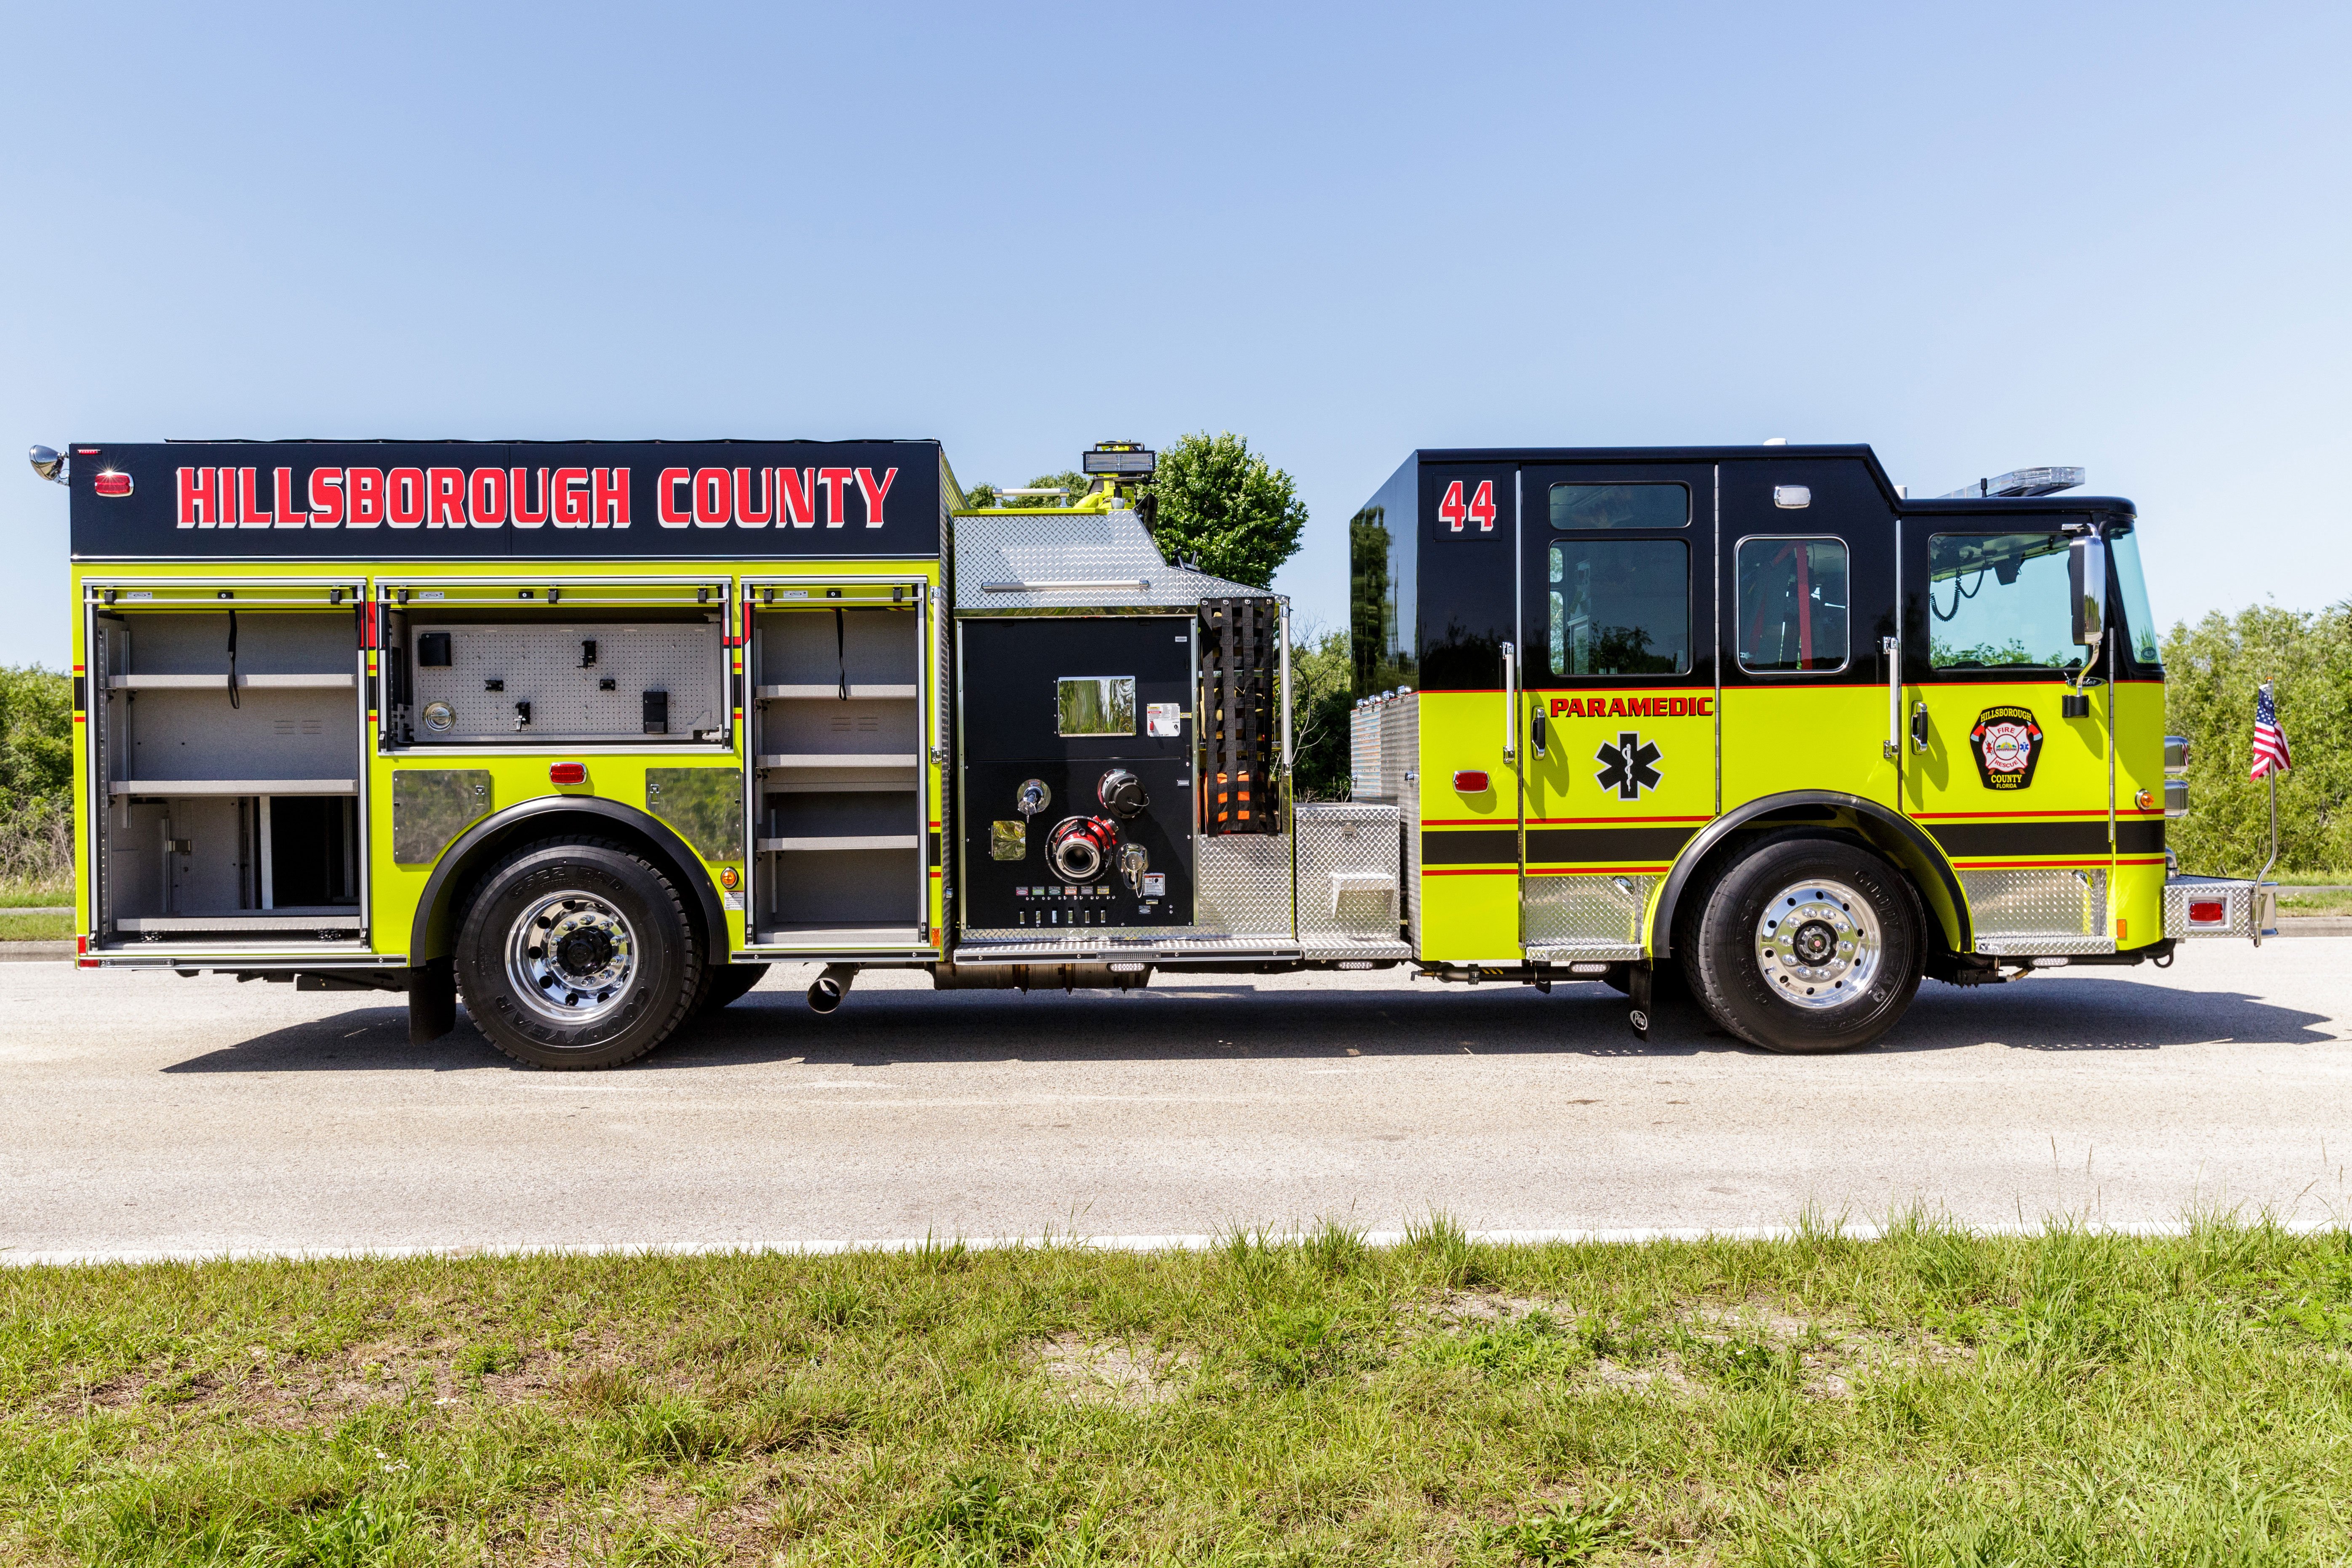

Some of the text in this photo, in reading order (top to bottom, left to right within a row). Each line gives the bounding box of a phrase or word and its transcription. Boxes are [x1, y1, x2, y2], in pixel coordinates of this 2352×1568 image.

[176, 467, 899, 529] HILLSBOROUGH COUNTY
[1439, 480, 1497, 532] 44
[1550, 697, 1714, 717] PARAMEDIC
[1980, 708, 2032, 722] HILLSBOROUGH
[1995, 760, 2019, 768] RESCUE
[1991, 774, 2022, 783] COUNTY
[495, 986, 650, 1045] GOODYEAR
